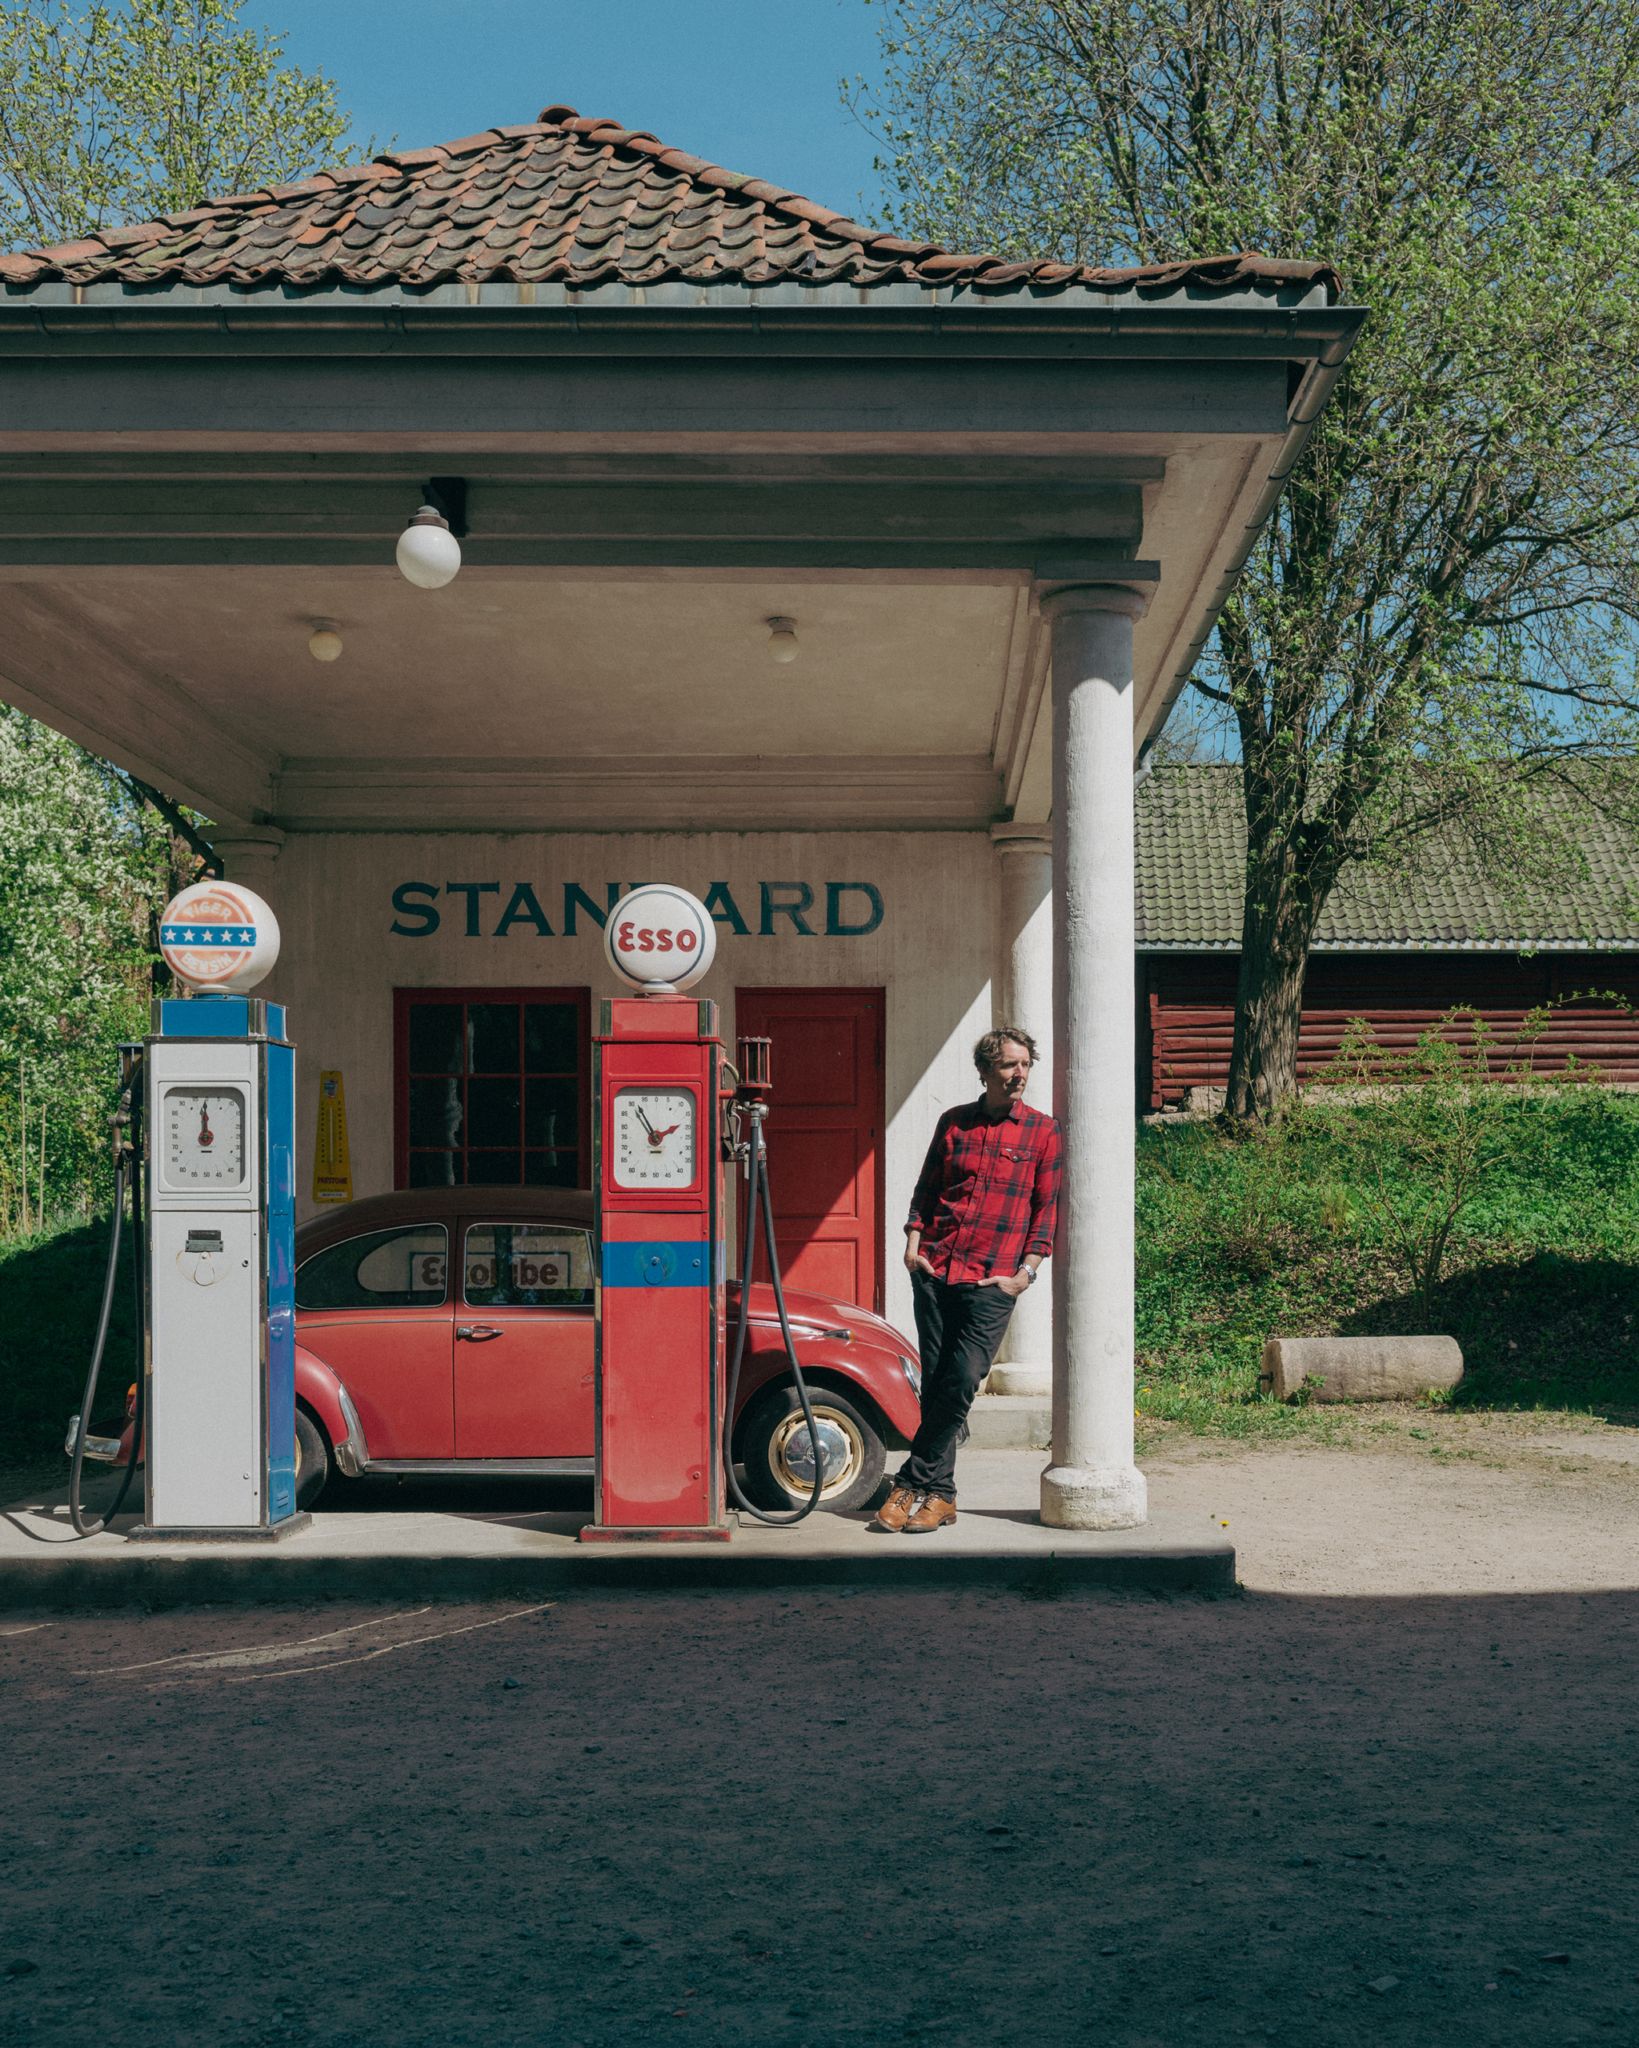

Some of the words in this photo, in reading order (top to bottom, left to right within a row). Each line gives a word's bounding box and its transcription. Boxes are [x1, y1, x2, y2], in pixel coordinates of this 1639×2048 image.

[183, 900, 232, 921] TIGER
[389, 881, 885, 938] STANARD
[181, 952, 233, 973] BENSIN
